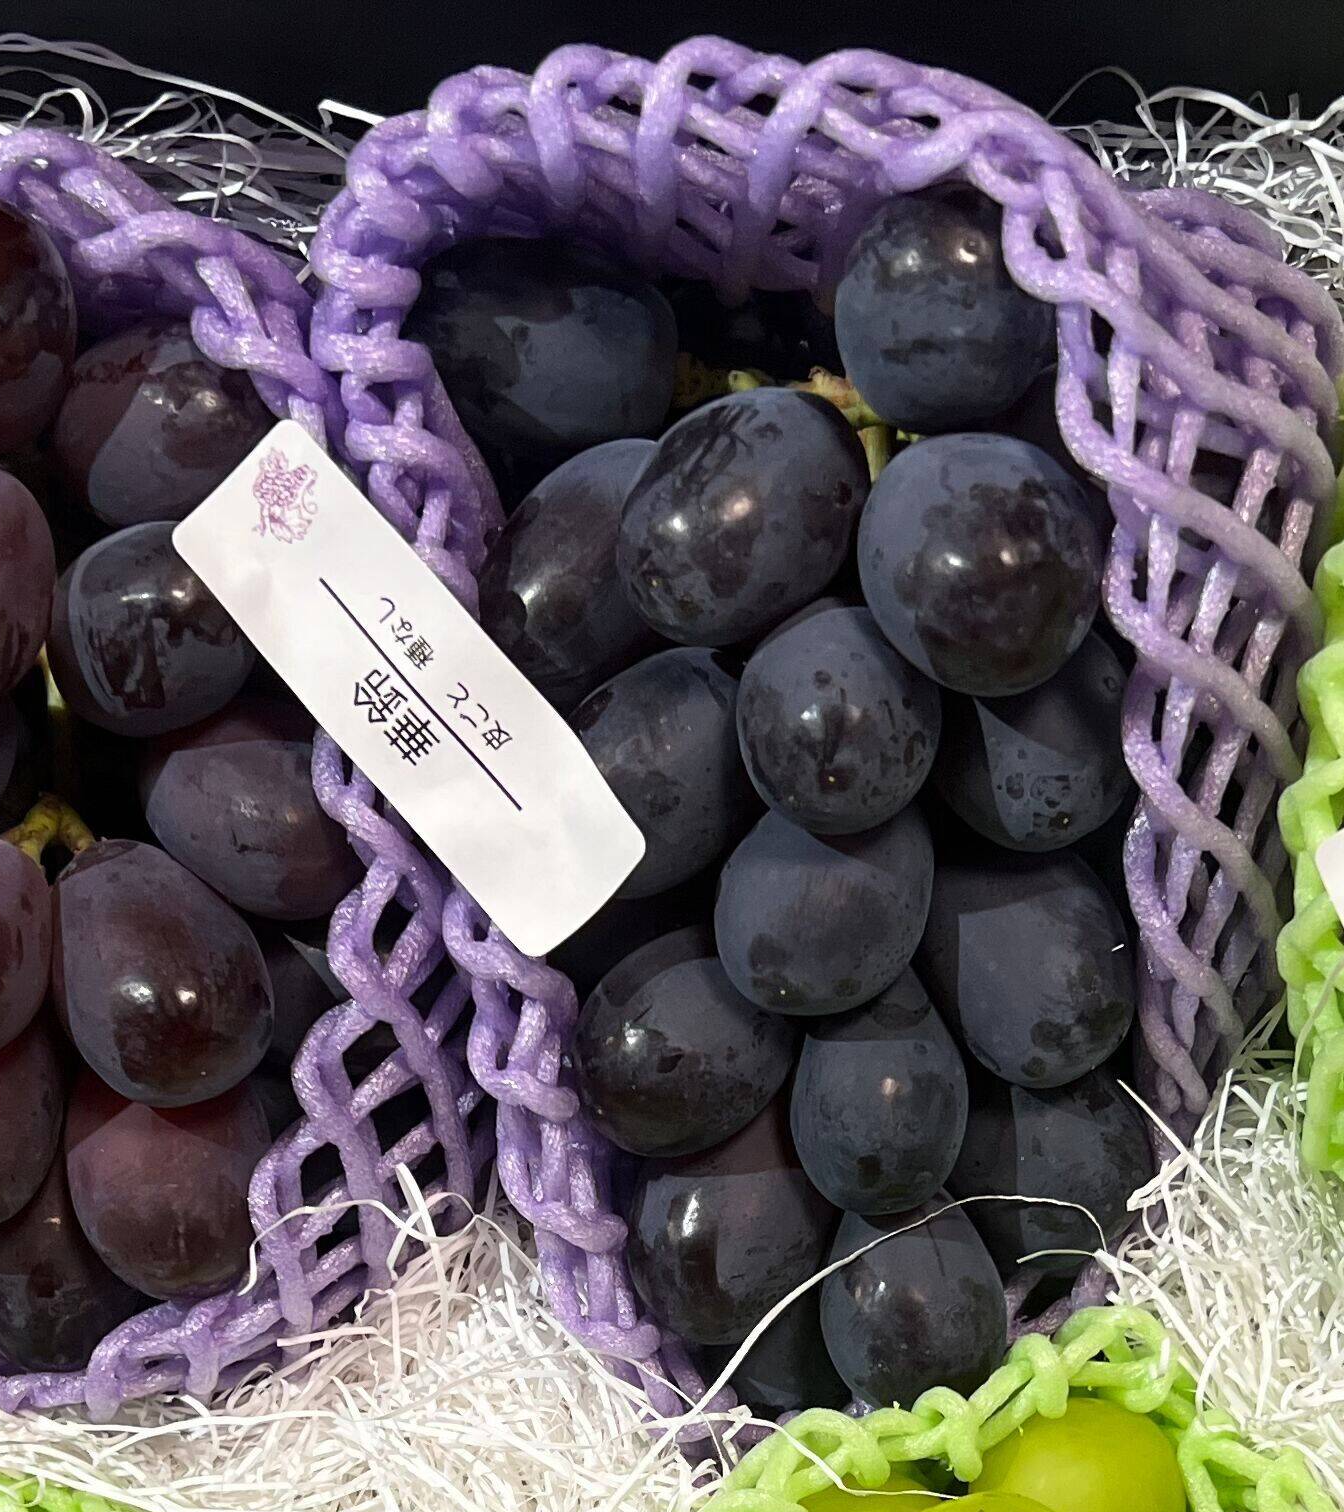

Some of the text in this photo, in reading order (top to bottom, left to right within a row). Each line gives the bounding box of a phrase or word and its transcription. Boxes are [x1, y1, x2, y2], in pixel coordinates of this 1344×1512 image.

[353, 668, 440, 766] 華鈴
[379, 597, 513, 751] 皮ごと 種なし
